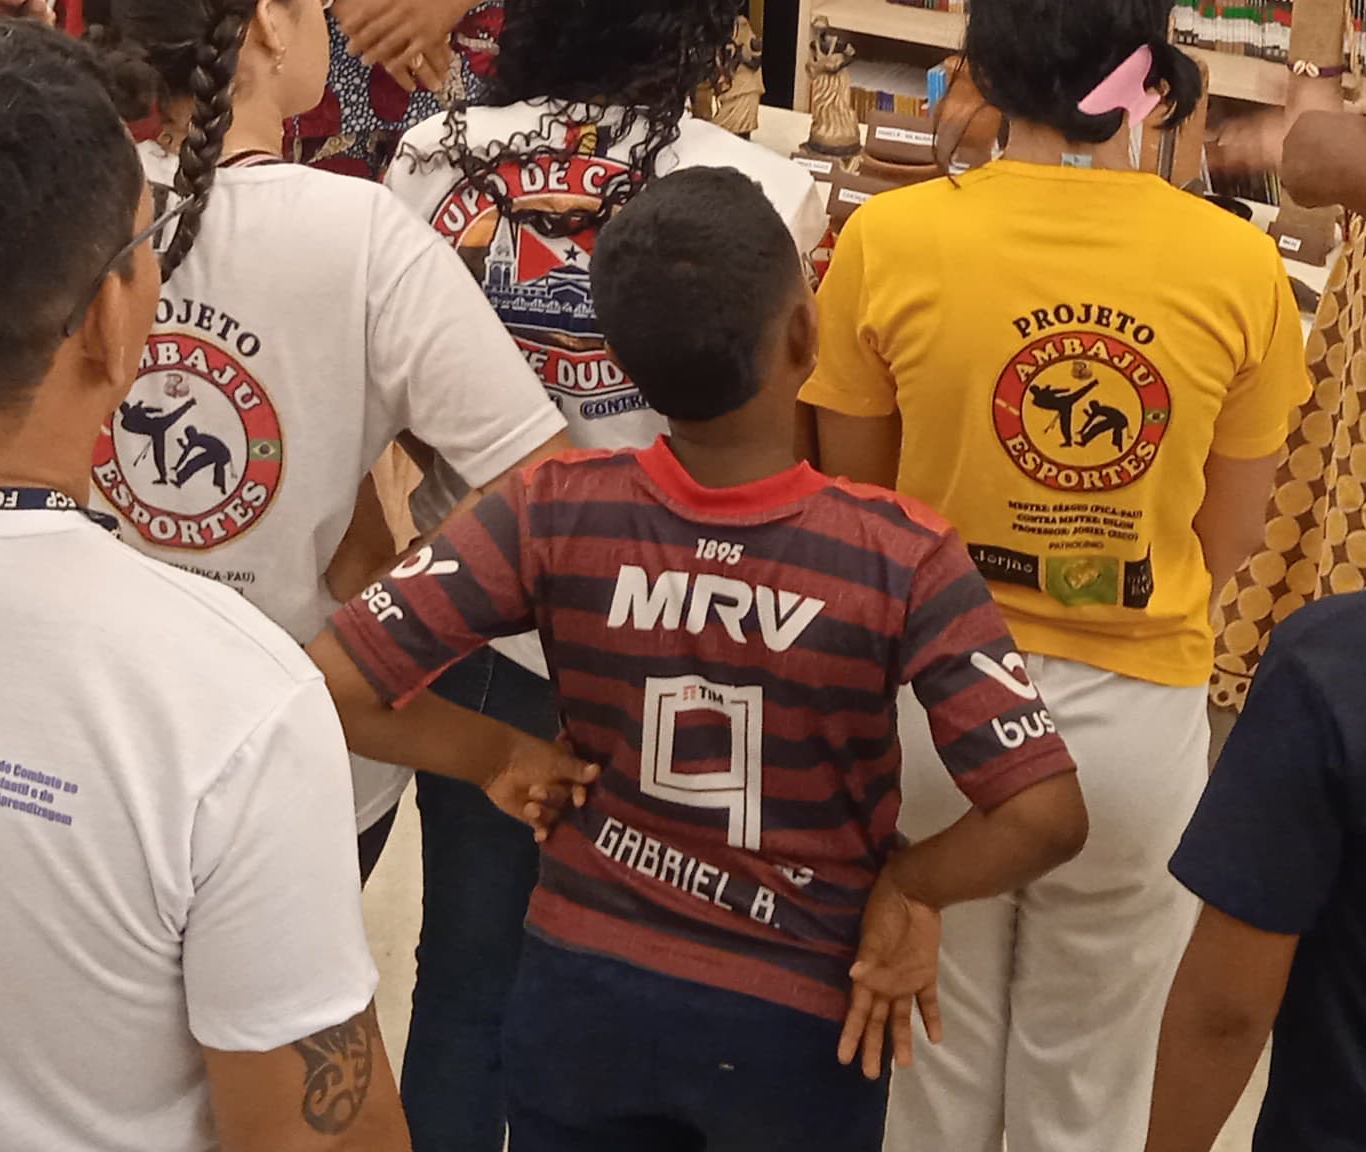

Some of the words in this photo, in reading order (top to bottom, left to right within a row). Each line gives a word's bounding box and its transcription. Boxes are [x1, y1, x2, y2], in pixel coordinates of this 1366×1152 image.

[1012, 303, 1155, 346] PROJETO
[1015, 337, 1155, 389] AMBAJU
[1006, 434, 1158, 490] ESPORTES
[93, 458, 268, 546] ESPORTES
[695, 538, 745, 565] 1895
[607, 564, 827, 653] MRV
[699, 686, 724, 706] TIM
[594, 816, 733, 911] GABRIEL
